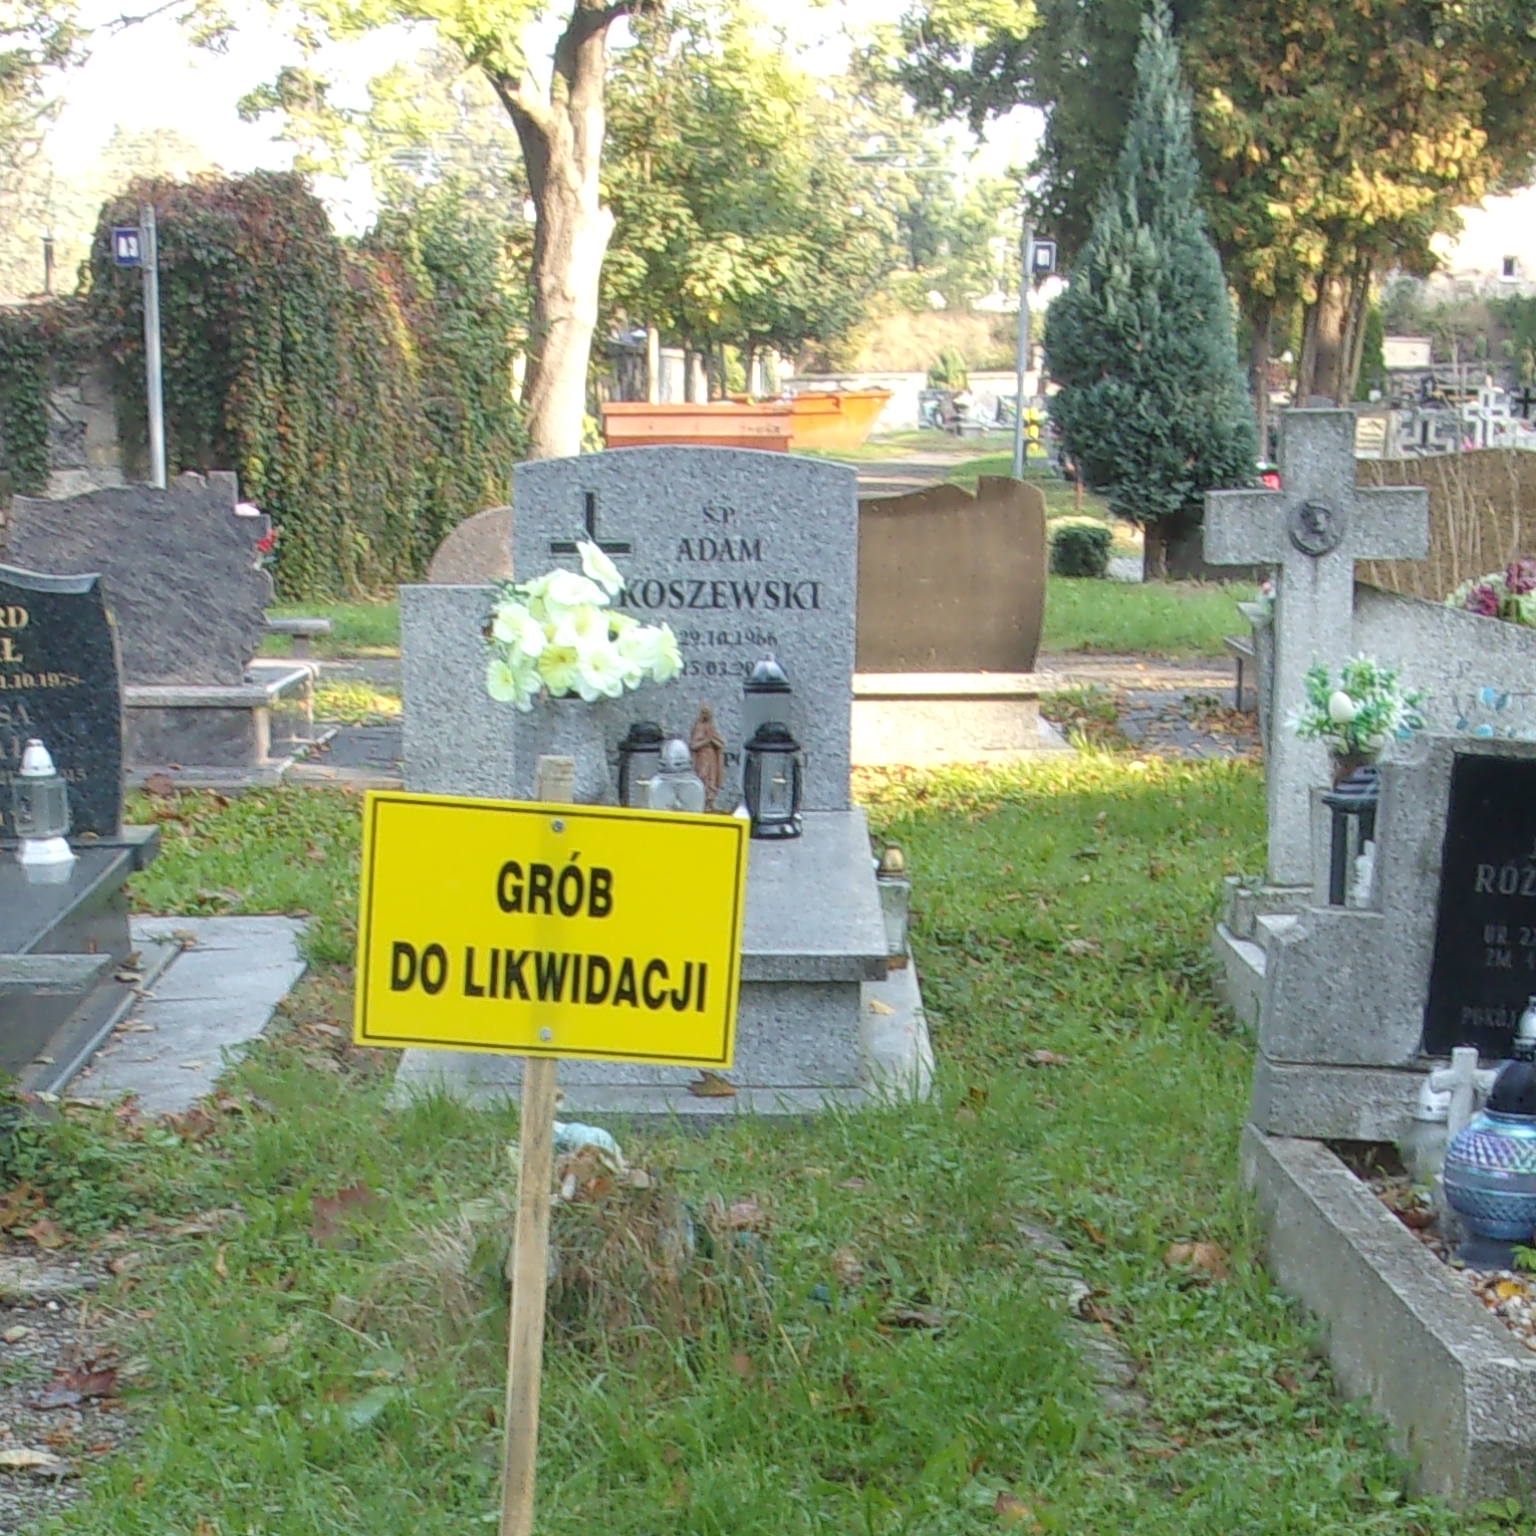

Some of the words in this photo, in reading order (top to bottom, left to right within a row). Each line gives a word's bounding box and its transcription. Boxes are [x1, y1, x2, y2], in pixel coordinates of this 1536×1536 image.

[676, 537, 764, 562] ADAM
[619, 579, 824, 611] KOSZEWSKI
[496, 851, 613, 918] GRÓB
[390, 941, 448, 995] DO
[464, 945, 708, 1013] LIKWIDACJI
